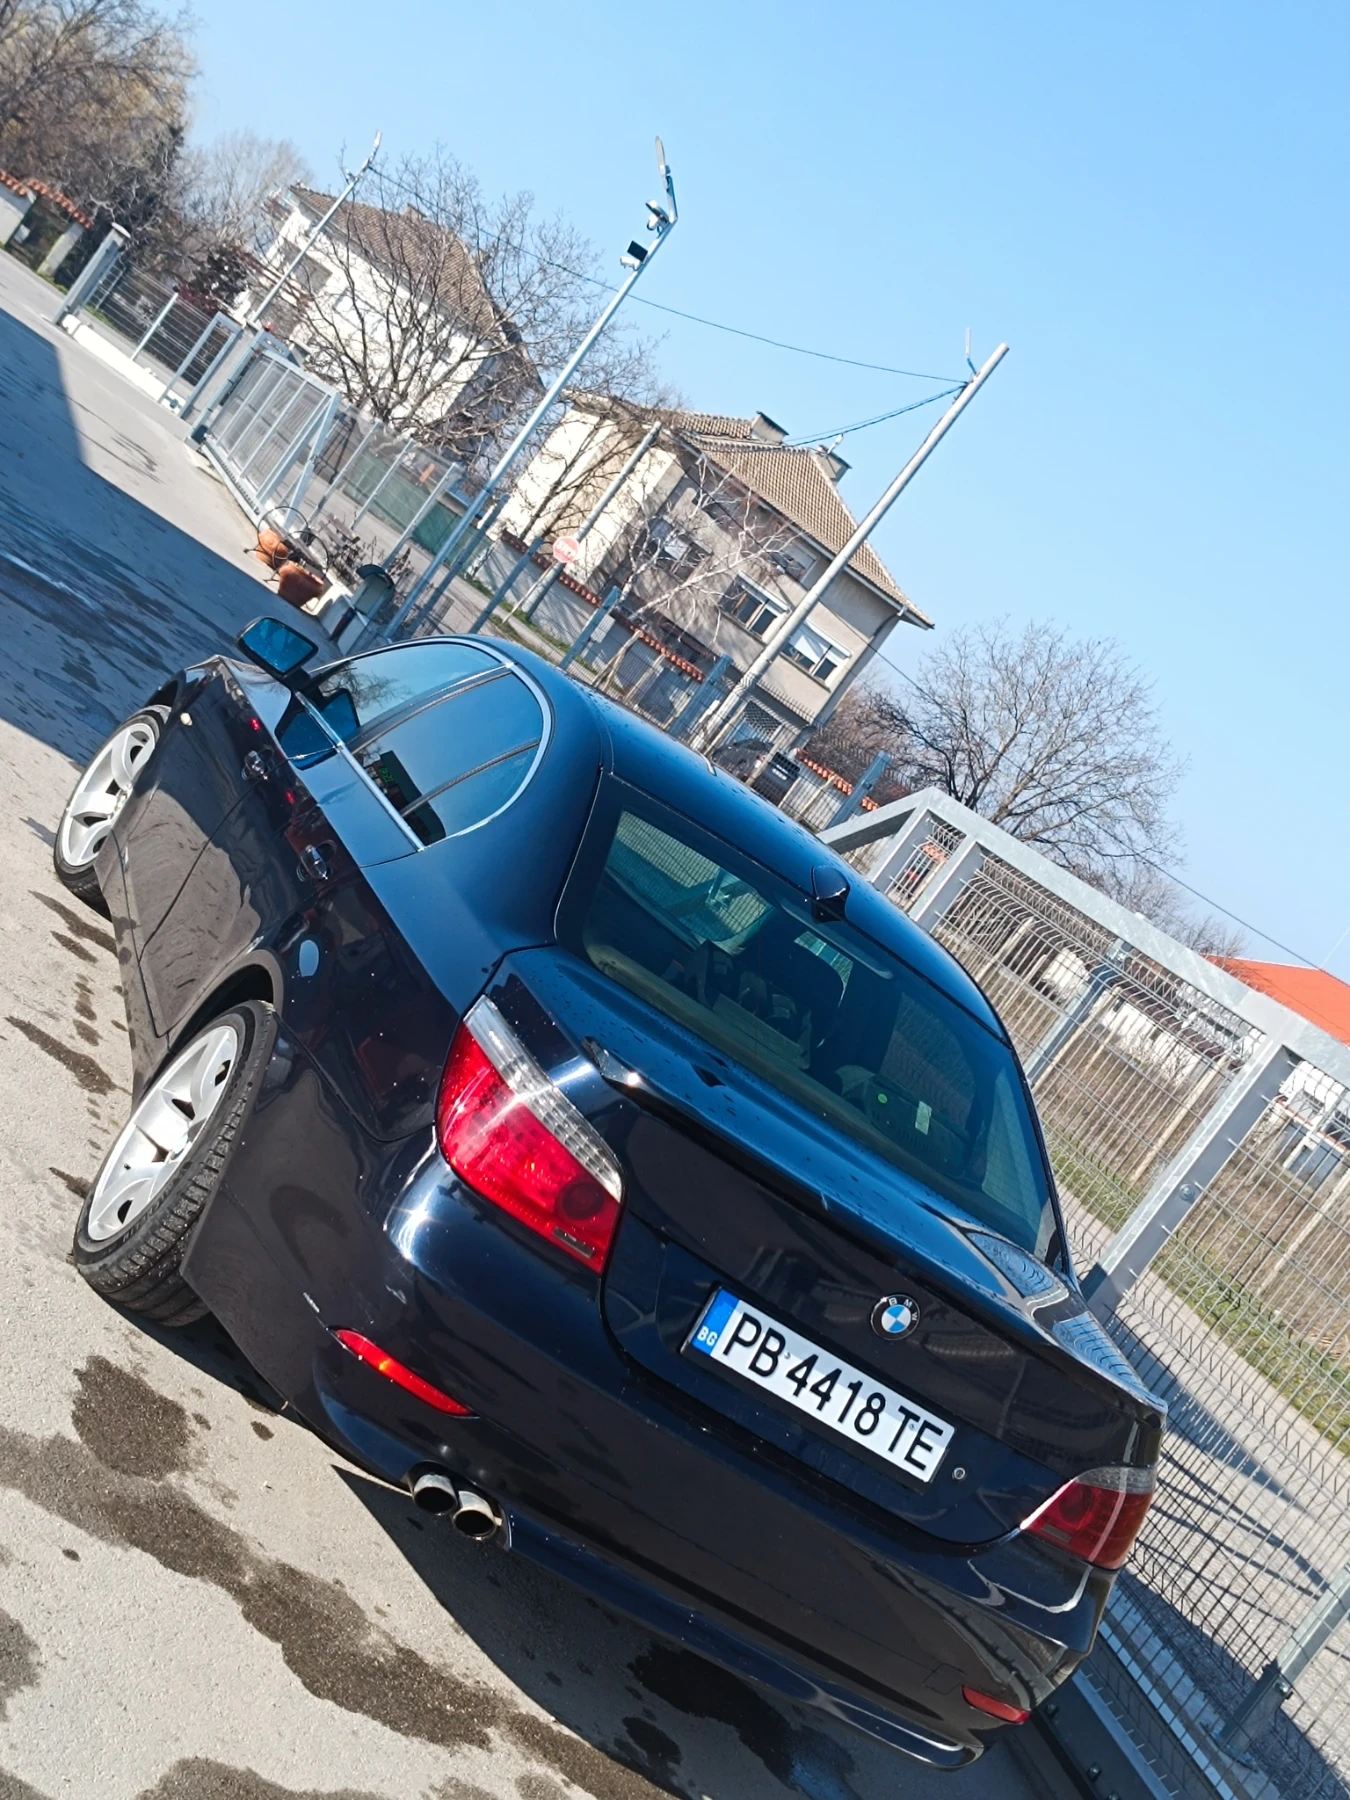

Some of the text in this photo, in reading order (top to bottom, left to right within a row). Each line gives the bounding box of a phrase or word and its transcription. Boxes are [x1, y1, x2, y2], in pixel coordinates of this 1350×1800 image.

[888, 1297, 918, 1321] BMW
[696, 1326, 716, 1346] BG
[722, 1312, 945, 1473] PB 4418 TE
